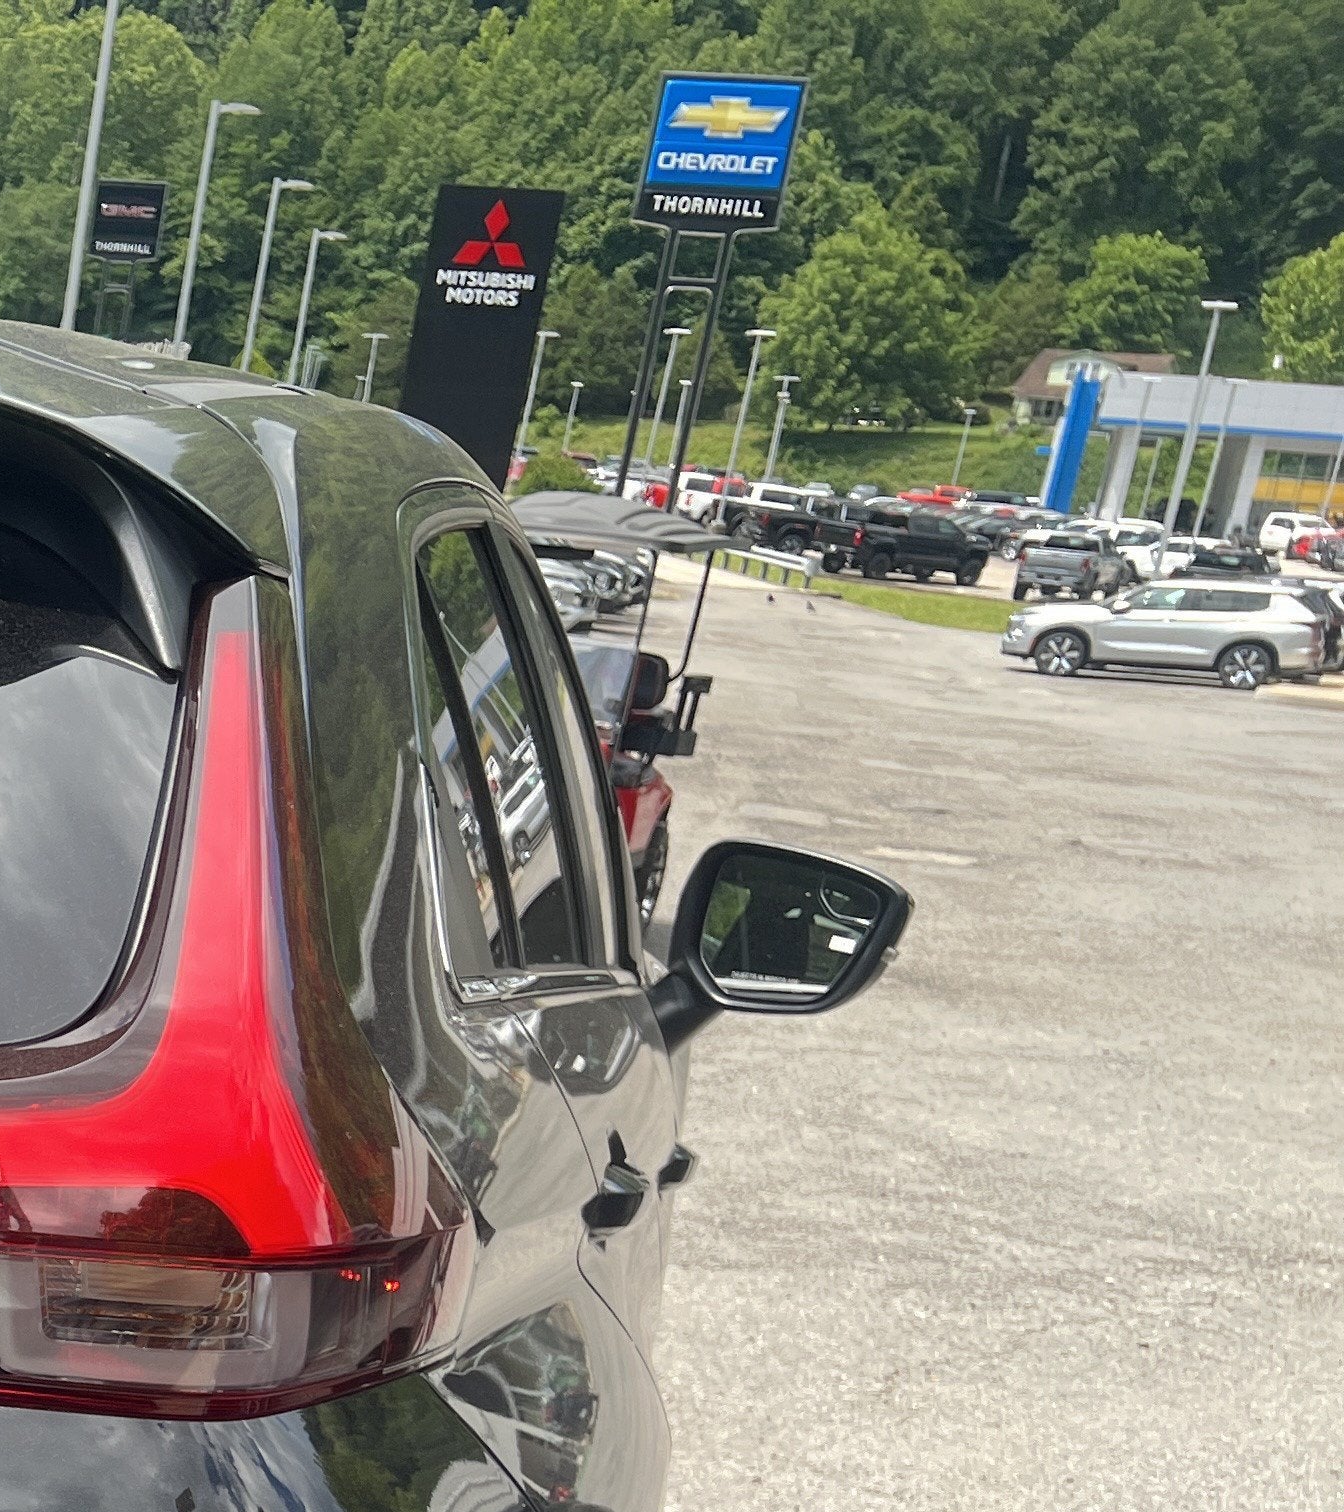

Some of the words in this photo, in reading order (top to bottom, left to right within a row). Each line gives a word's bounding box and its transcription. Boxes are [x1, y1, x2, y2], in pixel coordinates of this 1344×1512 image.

[657, 152, 778, 174] CHEVROLET
[100, 203, 157, 218] GMC
[653, 195, 764, 218] THORNHILL
[95, 241, 152, 255] THORNHILL
[436, 269, 536, 290] MITSUBISHI
[445, 287, 519, 306] MOTORS
